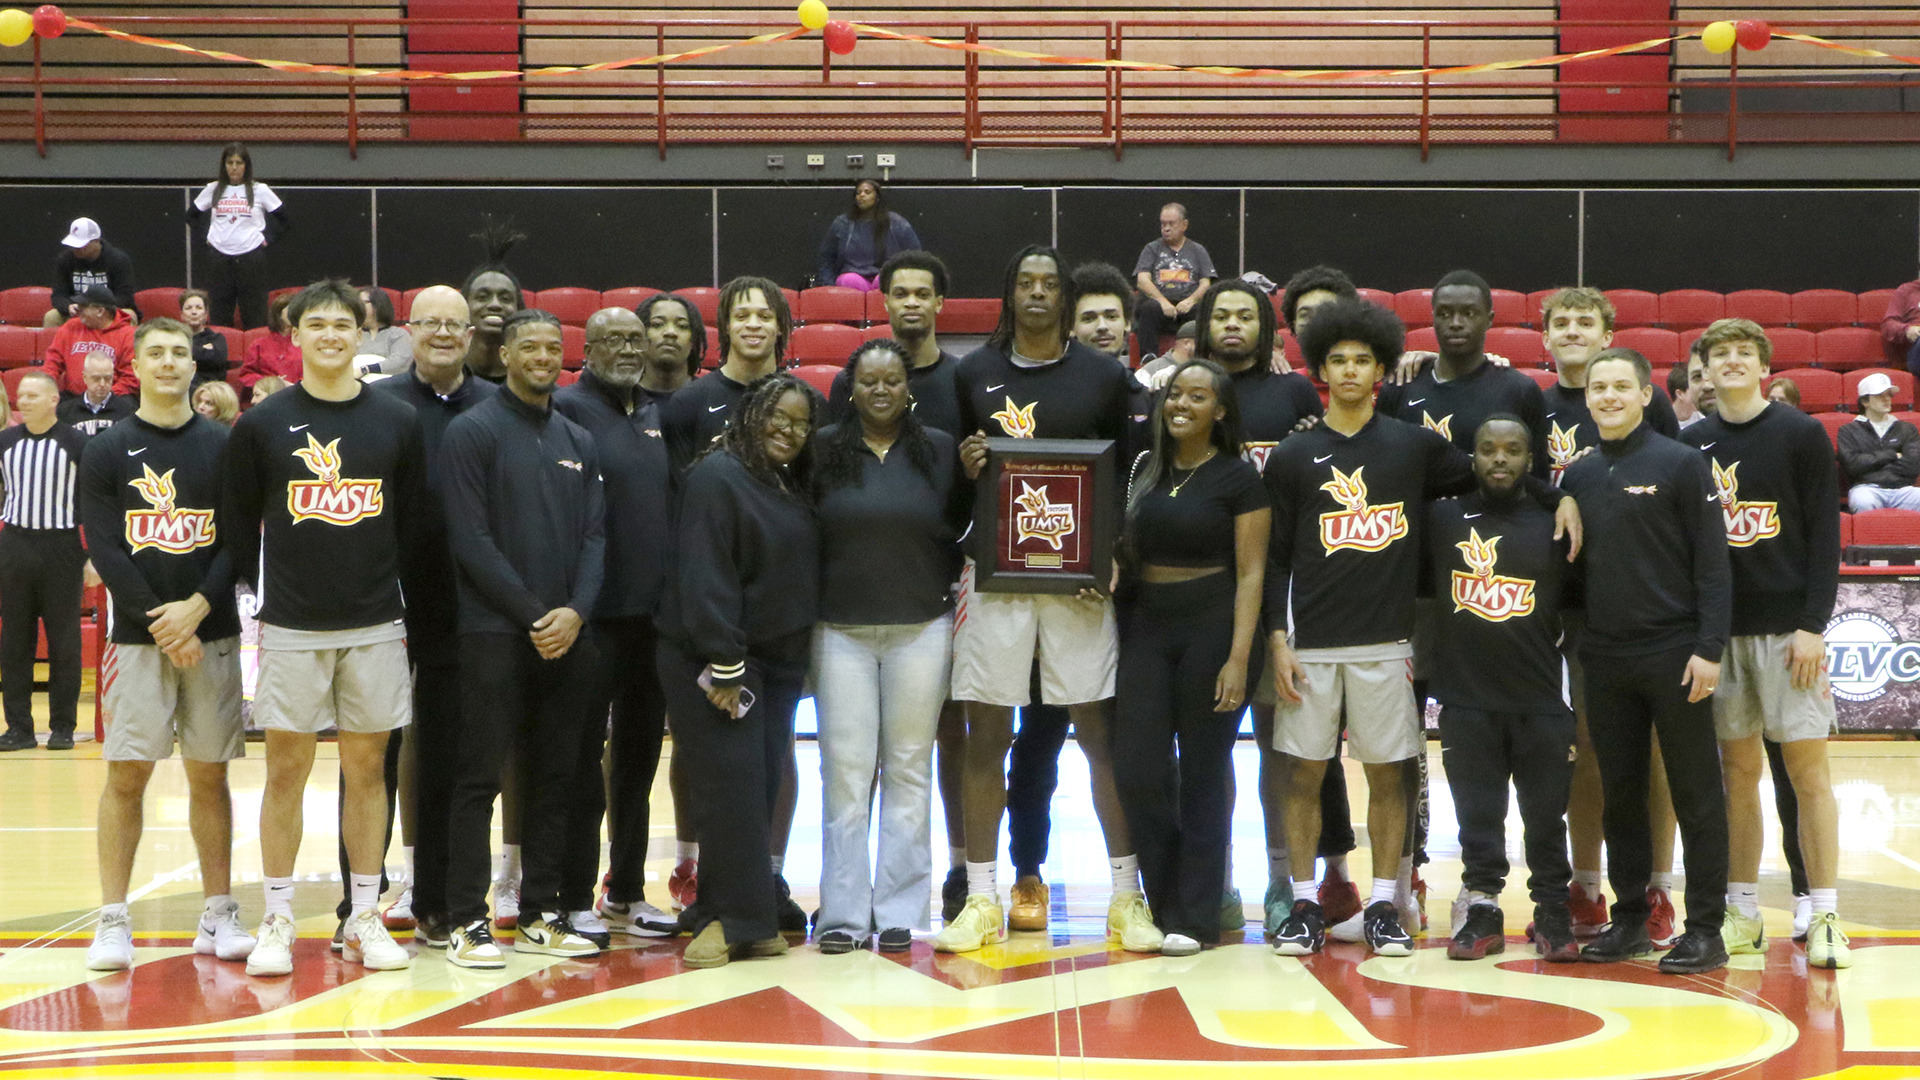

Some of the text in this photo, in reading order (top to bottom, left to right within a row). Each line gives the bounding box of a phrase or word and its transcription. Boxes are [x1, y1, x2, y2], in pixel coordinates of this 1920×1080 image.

[292, 483, 380, 522] UMSL
[131, 513, 214, 550] UMSL
[1022, 516, 1071, 535] UMSL
[1324, 508, 1405, 548] UMSL
[1722, 506, 1776, 542] MSL
[1455, 576, 1533, 617] UMSL
[1842, 612, 1870, 621] LAKES
[1871, 614, 1899, 638] VALLEY
[1829, 644, 1920, 680] LVC
[1830, 686, 1886, 702] CONFERENCE
